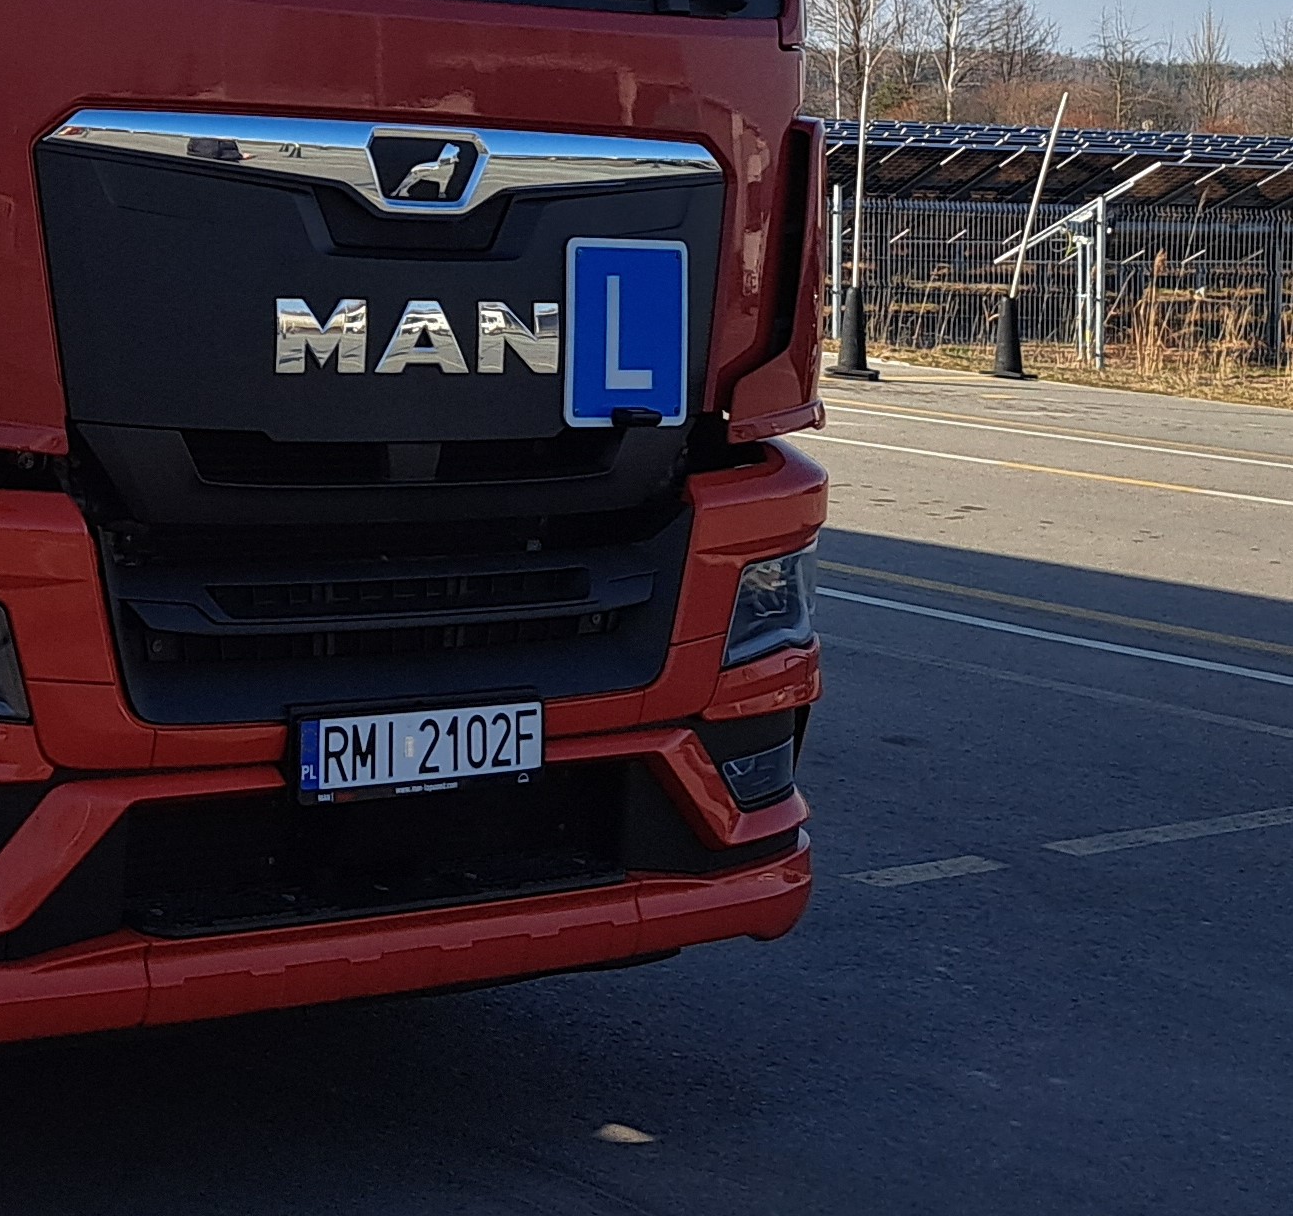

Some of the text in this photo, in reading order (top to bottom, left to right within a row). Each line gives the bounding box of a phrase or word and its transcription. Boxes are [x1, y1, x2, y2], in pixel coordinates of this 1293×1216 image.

[275, 298, 559, 373] MAN
[605, 274, 653, 390] L
[301, 764, 317, 781] PL
[324, 709, 537, 783] RMI 2102F
